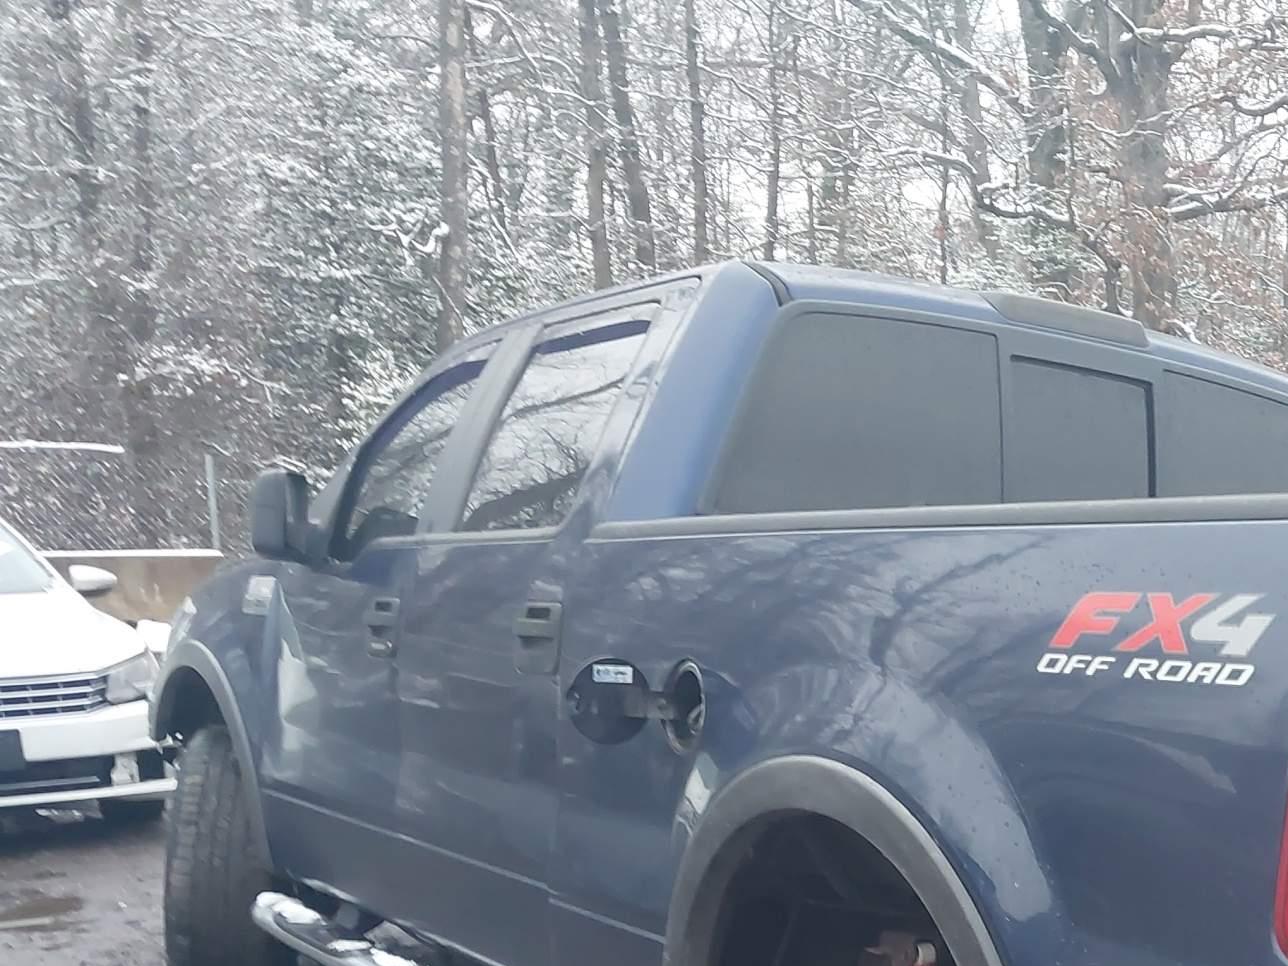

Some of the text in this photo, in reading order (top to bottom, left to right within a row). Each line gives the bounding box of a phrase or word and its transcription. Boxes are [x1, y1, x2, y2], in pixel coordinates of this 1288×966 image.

[1048, 592, 1277, 657] FX4
[1036, 653, 1256, 687] OFF ROAD
